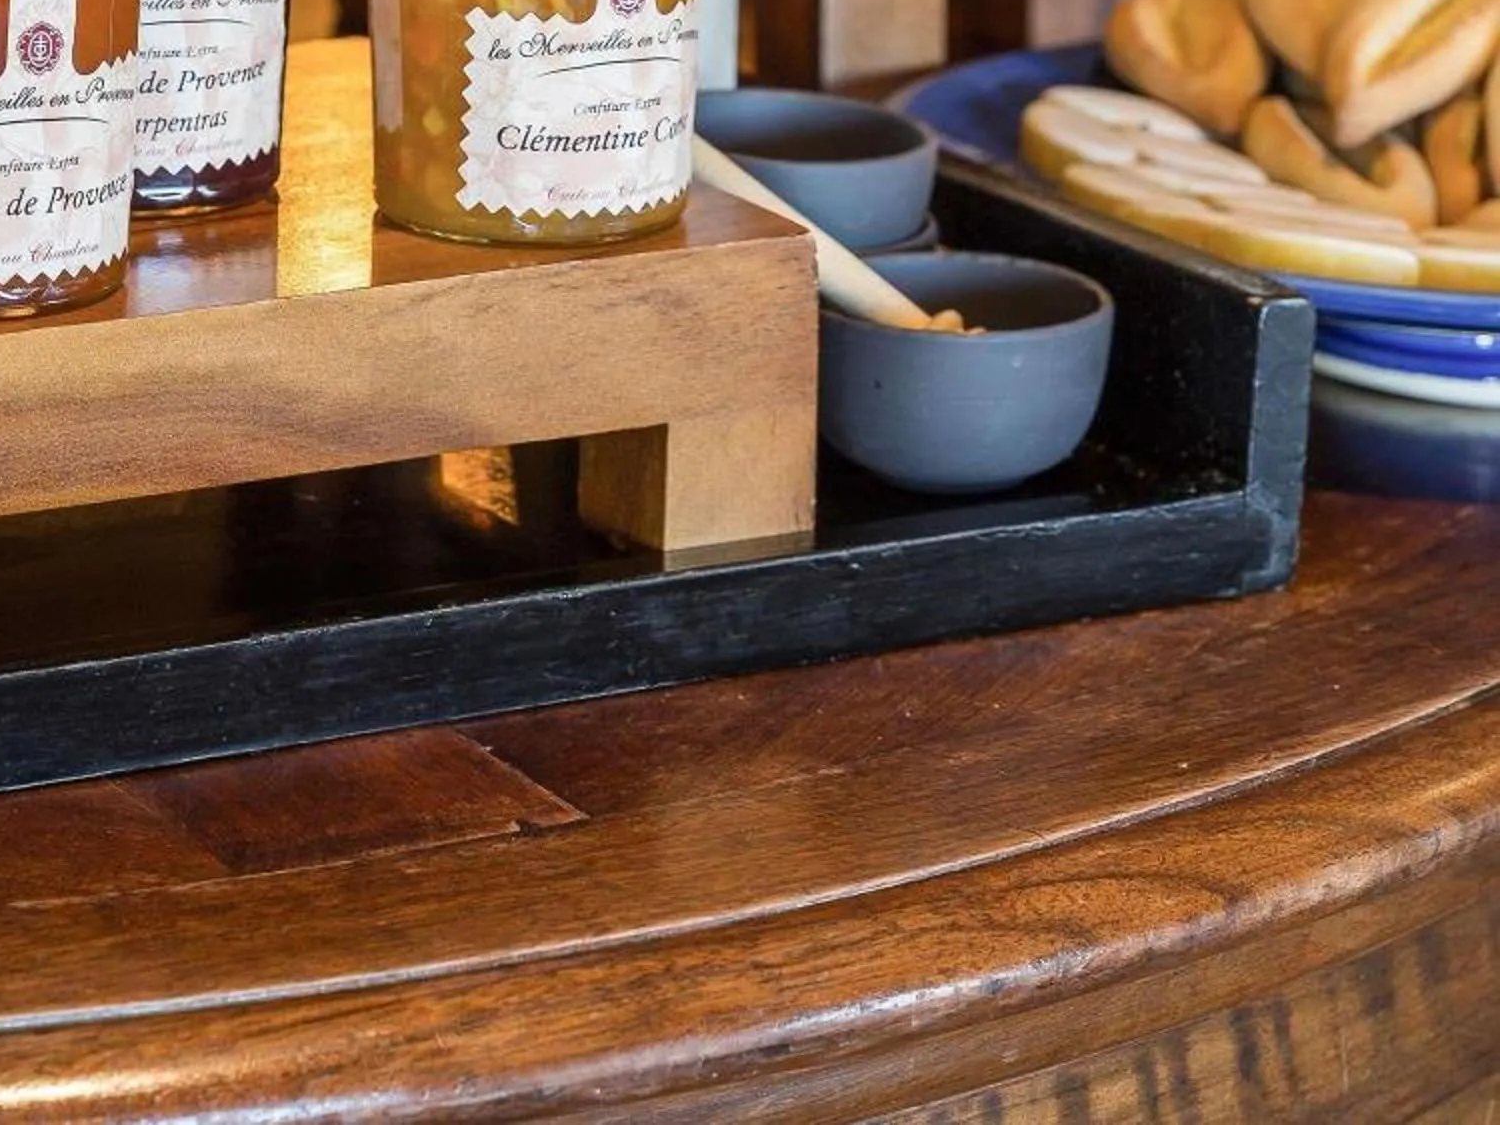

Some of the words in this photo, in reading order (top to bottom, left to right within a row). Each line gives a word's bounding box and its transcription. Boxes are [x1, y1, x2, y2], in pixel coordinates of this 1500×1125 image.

[488, 39, 512, 62] les
[518, 28, 632, 59] Merveilles
[637, 36, 653, 48] en
[138, 70, 169, 95] de
[176, 60, 267, 92] Provence
[49, 94, 70, 108] en
[496, 123, 650, 154] Clémentine
[47, 155, 80, 173] Extra
[6, 187, 39, 217] de
[46, 172, 129, 214] Provence
